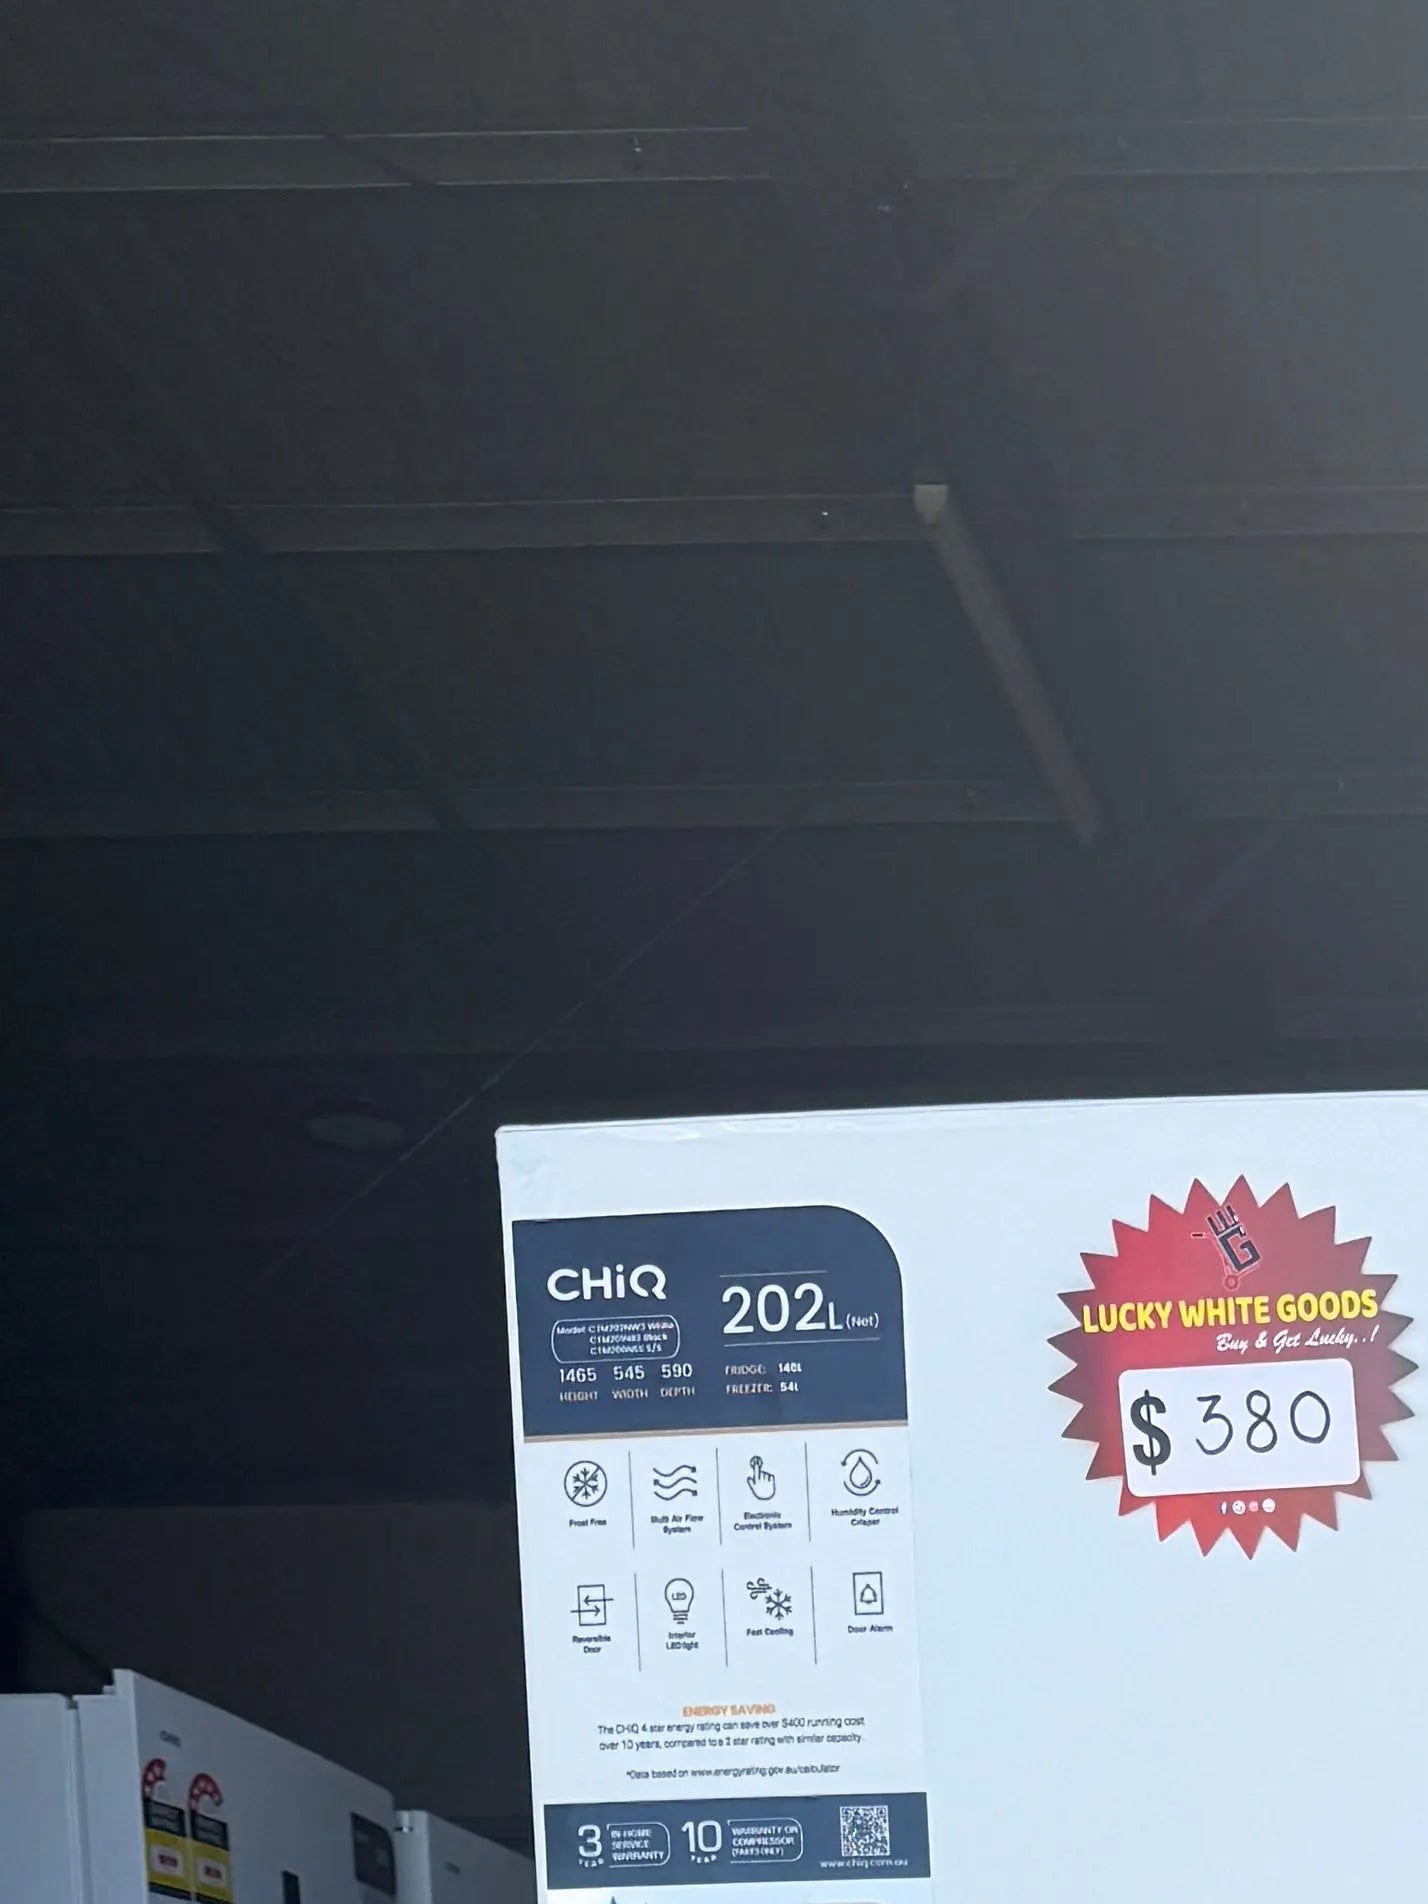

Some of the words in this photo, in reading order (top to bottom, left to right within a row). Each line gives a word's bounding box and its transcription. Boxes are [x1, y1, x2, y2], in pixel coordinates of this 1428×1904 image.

[547, 1264, 667, 1301] CHiQ
[1082, 1300, 1172, 1333] LUCKY
[1179, 1295, 1271, 1329] WHITE
[1277, 1289, 1378, 1325] GOODS
[1216, 1334, 1248, 1354] Buy
[1255, 1332, 1267, 1348] &
[1273, 1331, 1300, 1352] Get
[559, 1368, 597, 1383] 1465
[613, 1365, 645, 1380] 545
[661, 1363, 693, 1378] 590
[559, 1390, 599, 1402] HEIGHT
[612, 1388, 648, 1399] WIDTH
[660, 1386, 695, 1397] DEPTH
[1130, 1389, 1171, 1476] $
[1195, 1389, 1331, 1455] 380
[683, 1706, 727, 1717] ENERGY
[731, 1704, 776, 1716] SAVING
[578, 1825, 602, 1857] 3
[682, 1820, 722, 1852] 10
